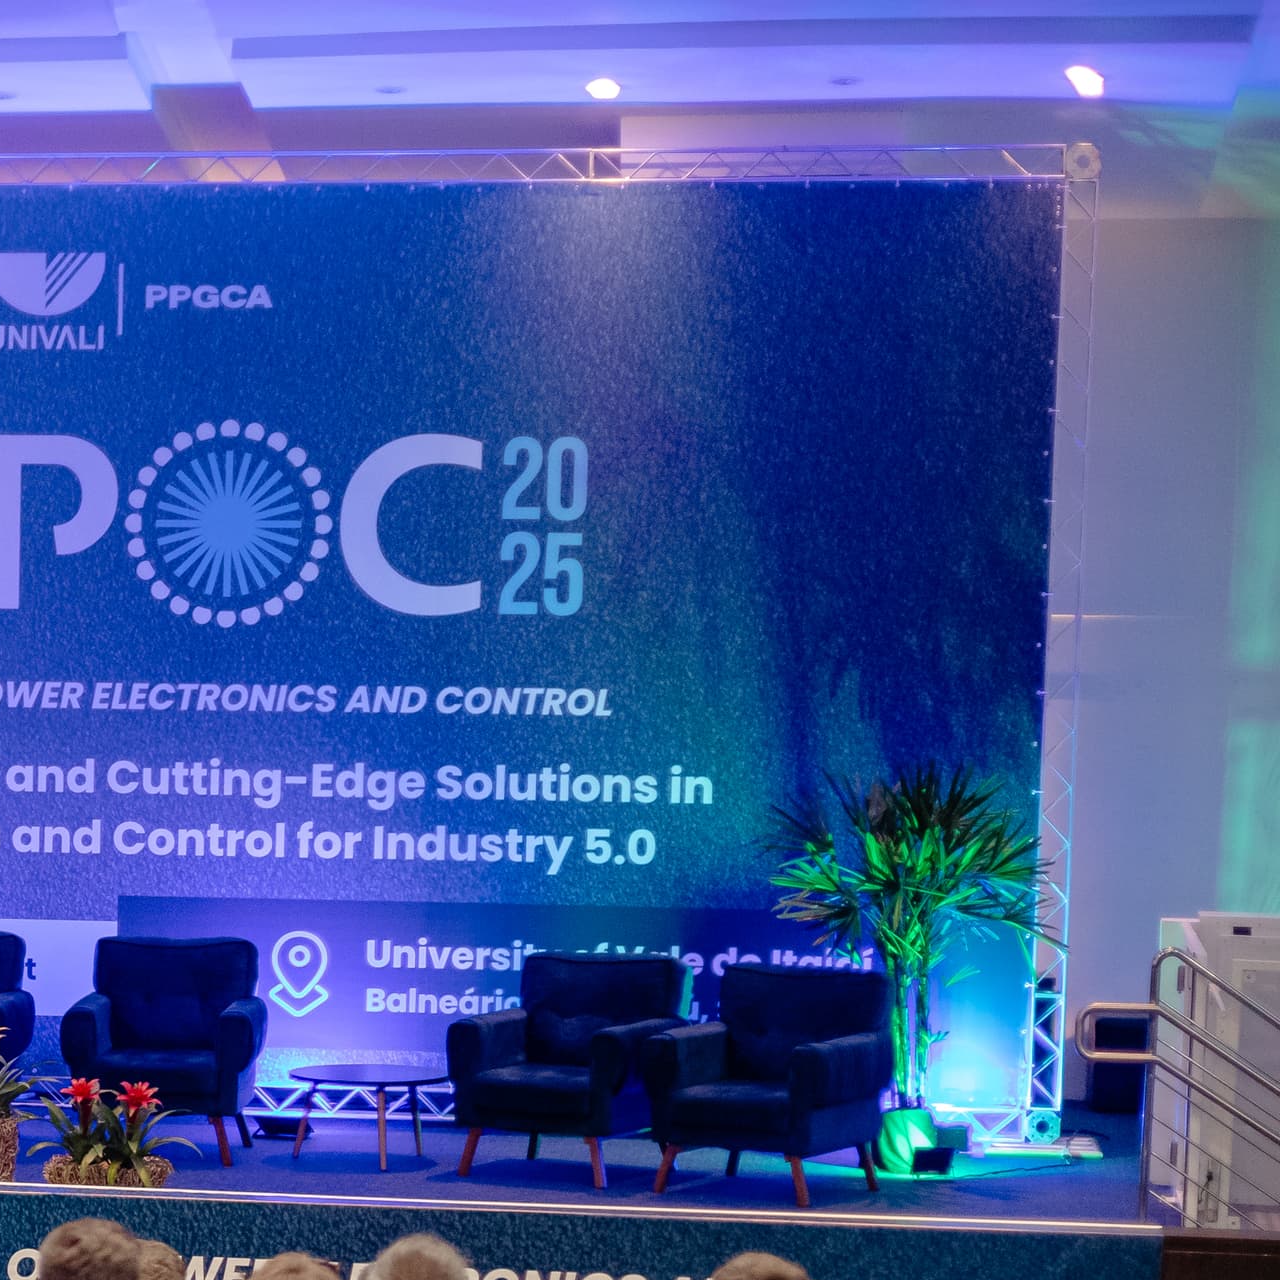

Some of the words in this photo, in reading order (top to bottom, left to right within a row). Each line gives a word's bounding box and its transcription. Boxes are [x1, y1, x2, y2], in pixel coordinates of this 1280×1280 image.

[144, 284, 273, 309] PPGCA
[502, 435, 589, 522] 20
[498, 531, 585, 616] 25
[90, 681, 338, 713] ELECTRONICS
[344, 685, 428, 715] AND
[435, 686, 614, 718] CONTROL
[4, 757, 97, 795] and
[106, 757, 427, 811] Cutting-Edge
[436, 764, 659, 804] Solutions
[669, 764, 714, 804] in
[11, 817, 103, 854] and
[112, 820, 286, 858] Control
[297, 821, 362, 860] for
[372, 824, 573, 875] Industry
[583, 828, 657, 865] 5.0
[366, 937, 546, 972] Universi
